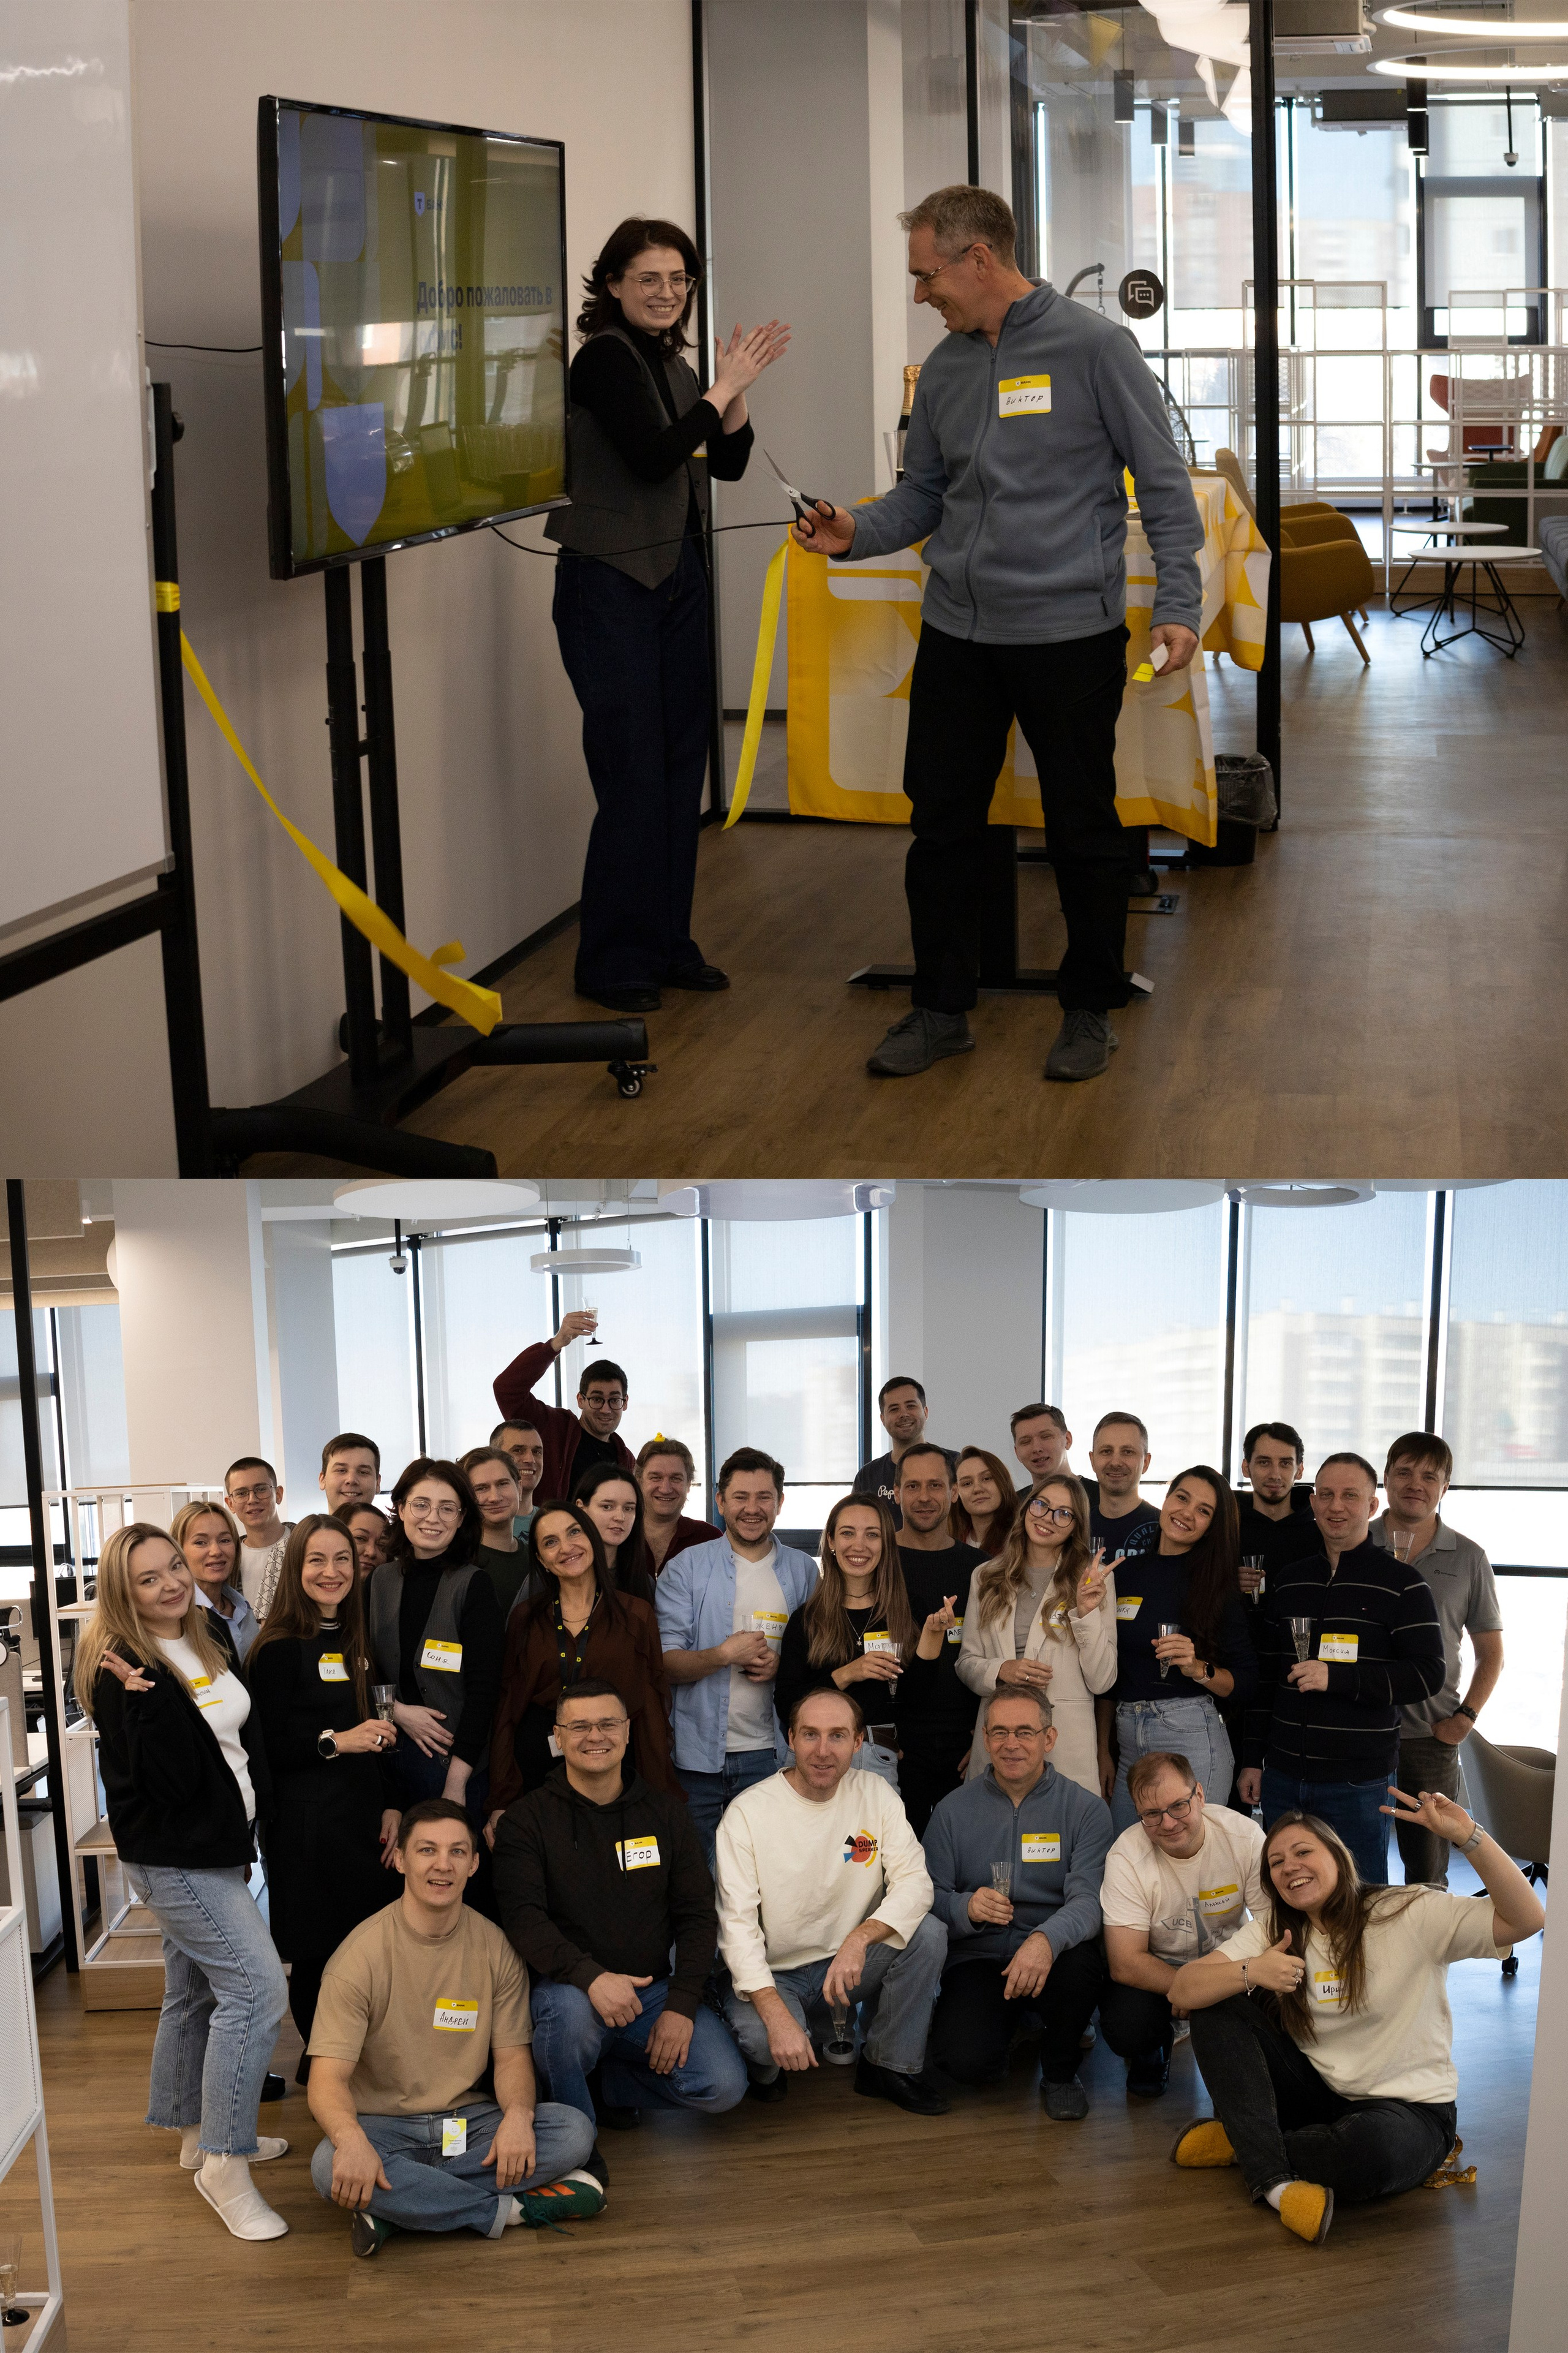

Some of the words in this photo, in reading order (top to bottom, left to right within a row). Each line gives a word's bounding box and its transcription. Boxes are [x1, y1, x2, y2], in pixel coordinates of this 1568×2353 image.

[417, 280, 464, 314] Добро
[467, 285, 543, 308] пожаловать
[545, 285, 552, 306] в
[1006, 395, 1044, 406] Виктор
[878, 1485, 895, 1500] Pep
[1129, 1525, 1155, 1546] QUAL
[868, 1642, 894, 1651] Мари
[427, 1652, 450, 1666] Соня
[858, 1840, 878, 1848] DUMP
[626, 1850, 652, 1864] Егор
[1172, 1918, 1193, 1928] UCB
[1323, 1985, 1344, 1996] Ири
